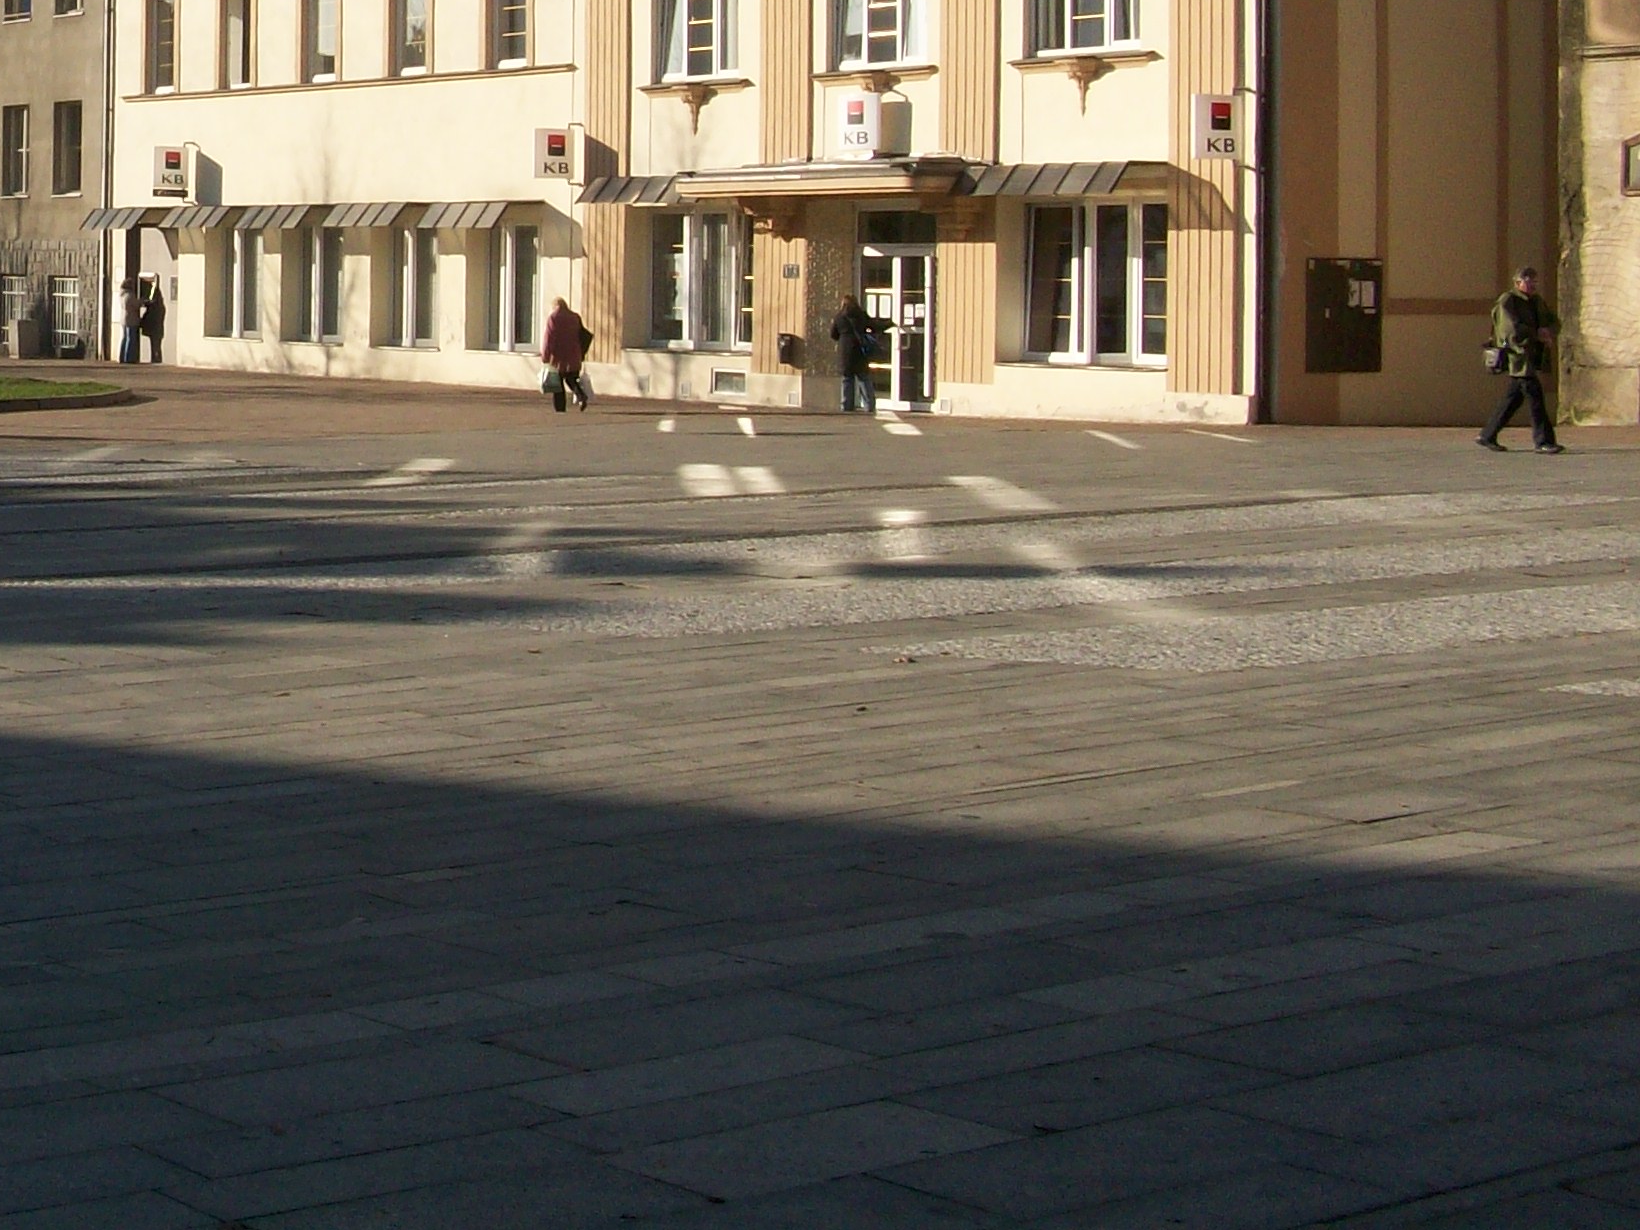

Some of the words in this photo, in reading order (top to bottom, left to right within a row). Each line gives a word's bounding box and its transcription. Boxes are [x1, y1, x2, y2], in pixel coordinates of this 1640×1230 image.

[844, 131, 869, 145] KB
[1207, 138, 1235, 153] KB
[544, 162, 569, 174] KB
[162, 174, 184, 185] KB
